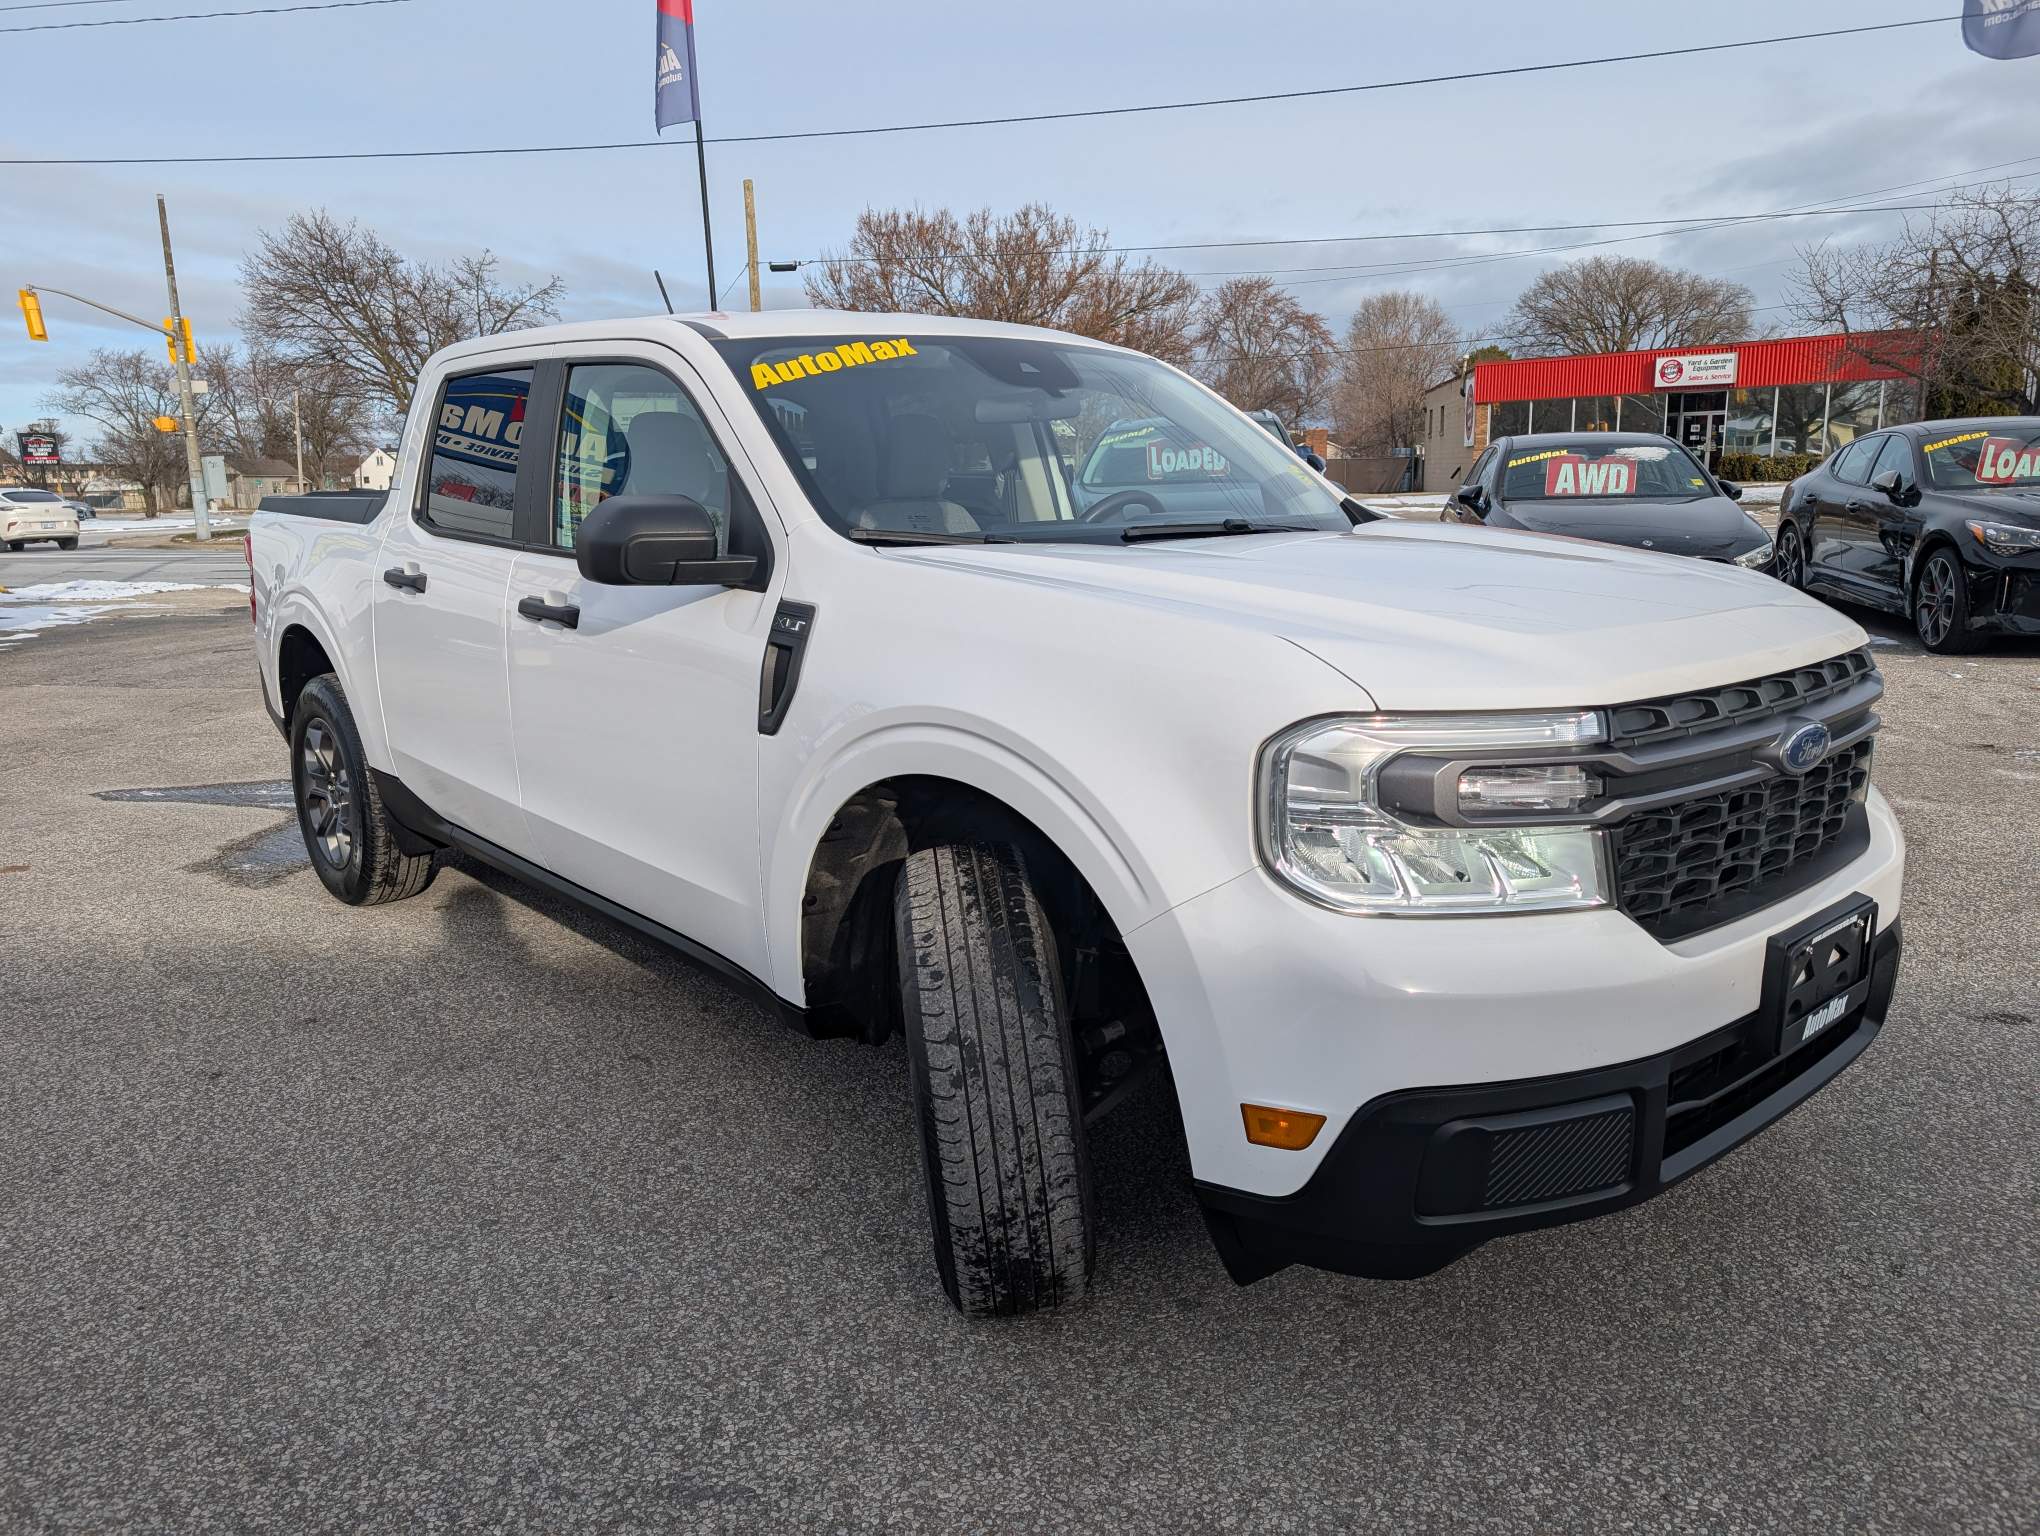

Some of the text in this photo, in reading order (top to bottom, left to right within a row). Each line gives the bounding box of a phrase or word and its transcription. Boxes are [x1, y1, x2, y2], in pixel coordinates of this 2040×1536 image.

[750, 338, 918, 390] AutoMax
[1692, 364, 1727, 372] Equipment
[1924, 431, 1990, 453] AutoMax
[1150, 446, 1225, 473] LOADED
[1508, 449, 1569, 468] AutoMax
[1554, 463, 1629, 494] AWD
[1802, 995, 1849, 1041] AutoMax
